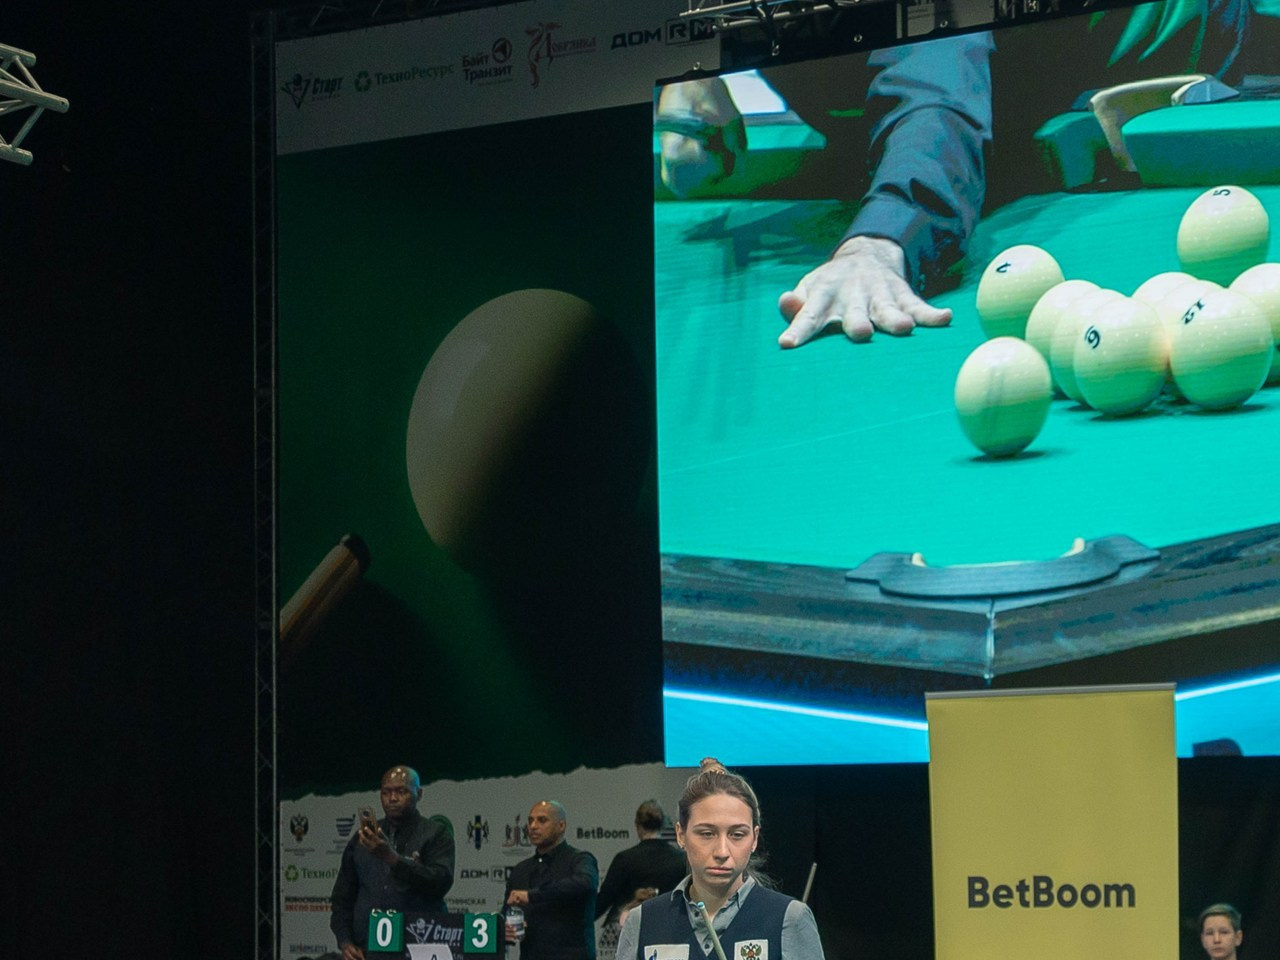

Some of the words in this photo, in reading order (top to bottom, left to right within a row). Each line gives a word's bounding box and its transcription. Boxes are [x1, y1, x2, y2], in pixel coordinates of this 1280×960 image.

[611, 28, 661, 50] ДОМ
[462, 53, 489, 68] Байт
[374, 64, 456, 85] ТехноРесурс
[463, 65, 512, 85] Транзит
[312, 77, 344, 97] Старт
[576, 827, 630, 840] BetBoom
[460, 869, 489, 881] ДОМ
[967, 875, 1136, 909] BetBoom
[376, 917, 393, 948] 0
[433, 925, 464, 941] Старт
[471, 918, 489, 948] 3
